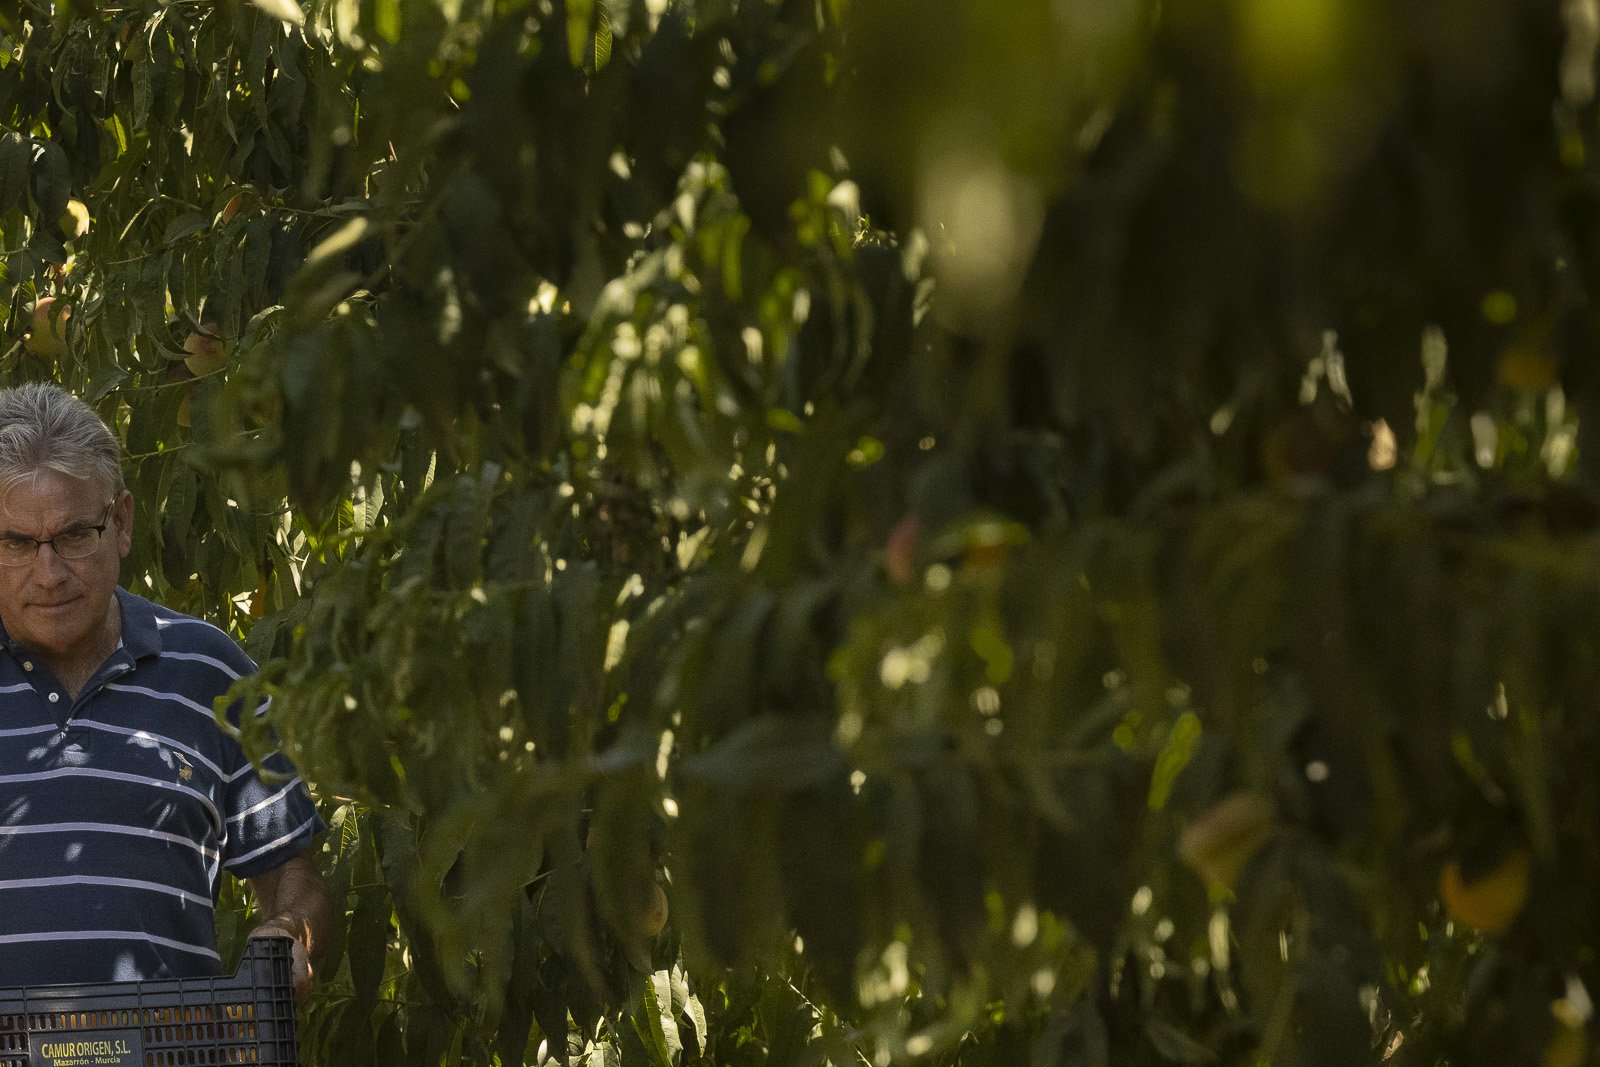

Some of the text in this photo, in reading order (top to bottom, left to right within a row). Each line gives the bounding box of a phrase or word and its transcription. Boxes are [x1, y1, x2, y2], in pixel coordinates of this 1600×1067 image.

[41, 1040, 131, 1058] CAMUR ORIGEN, S.L.
[53, 1058, 89, 1067] Mazarrón
[95, 1057, 121, 1065] Murcia
